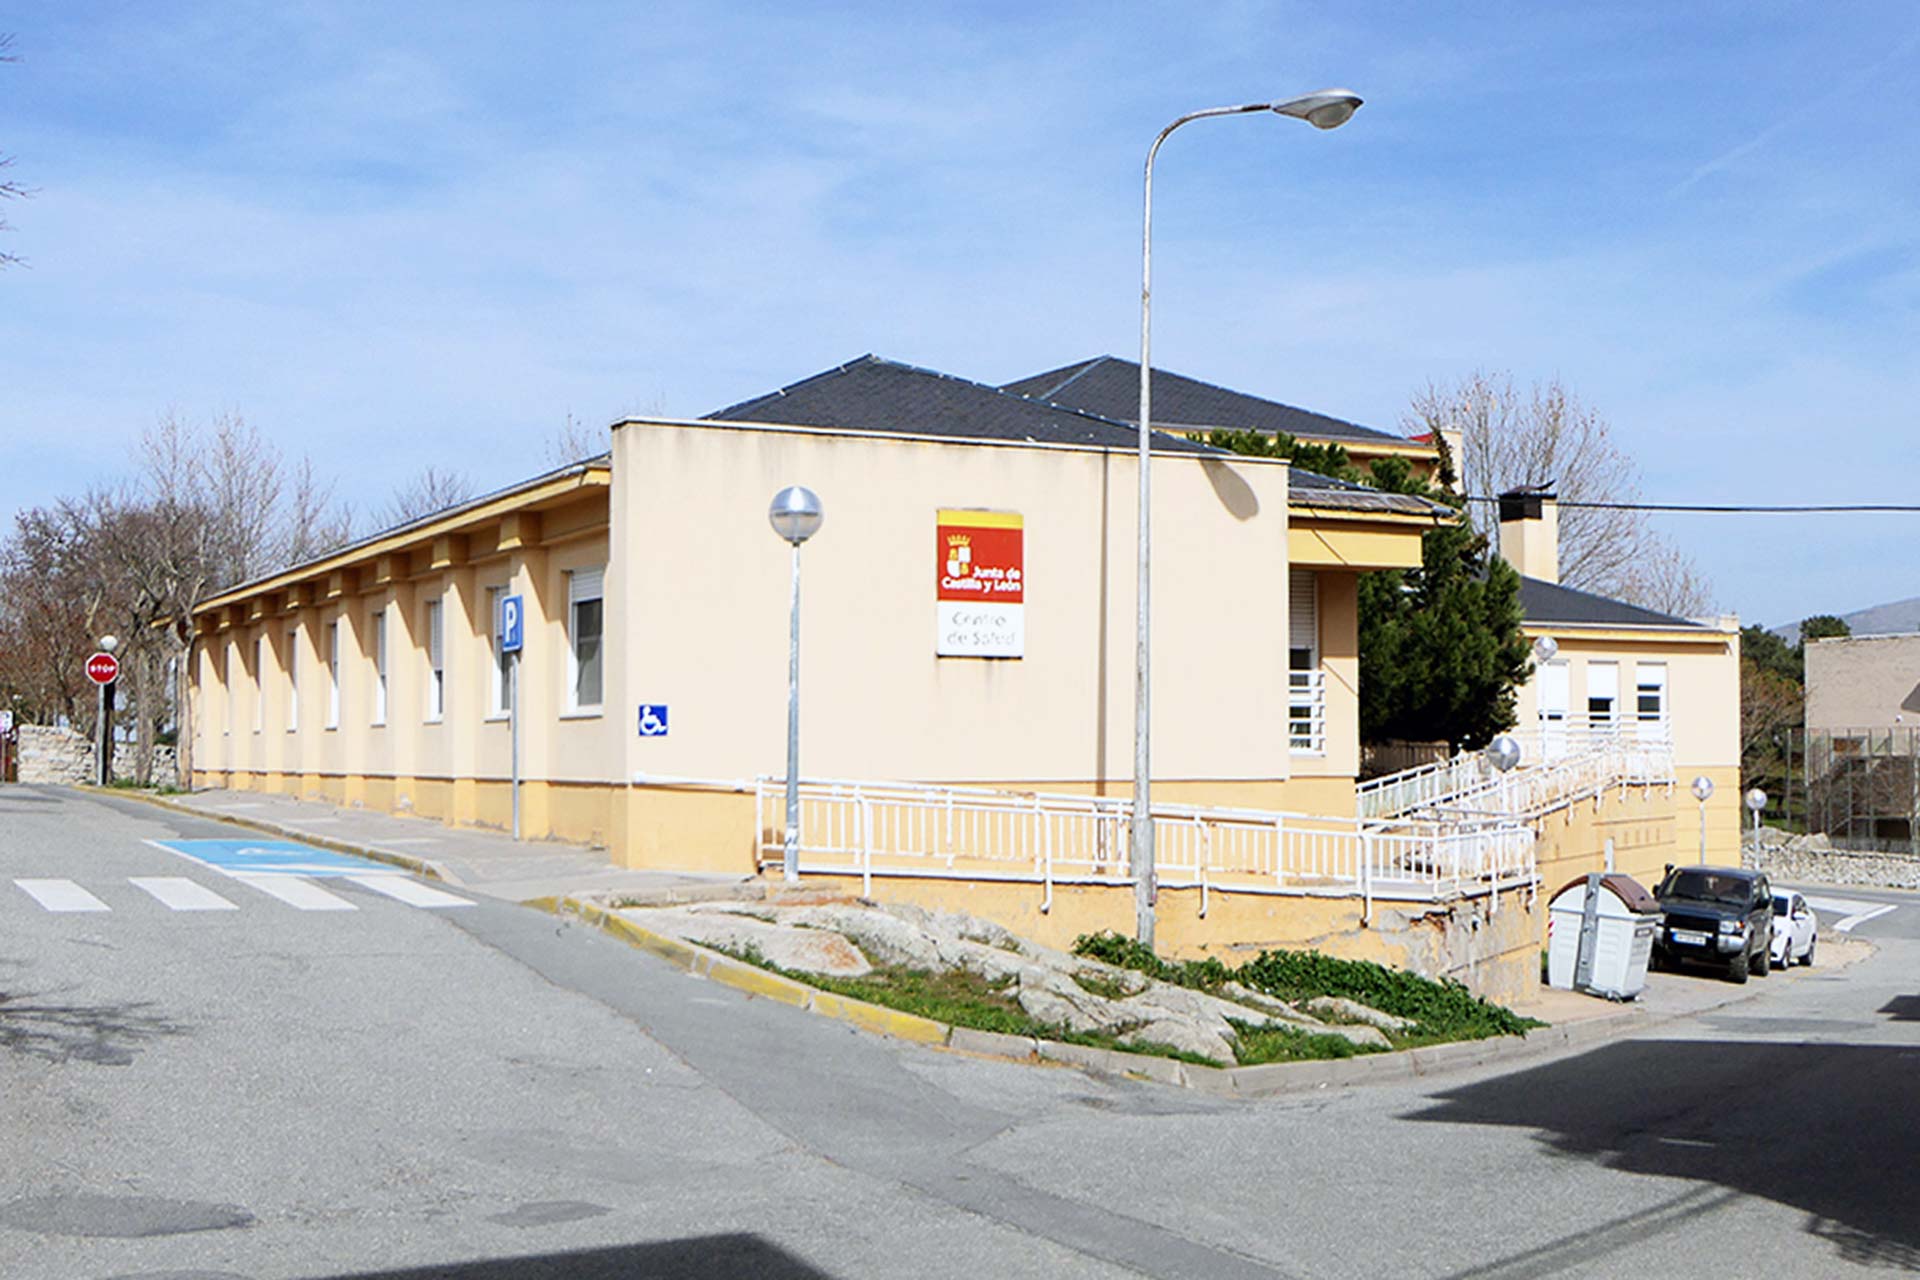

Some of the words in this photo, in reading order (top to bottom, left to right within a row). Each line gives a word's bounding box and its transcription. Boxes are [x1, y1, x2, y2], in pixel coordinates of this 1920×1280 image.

[973, 565, 1004, 579] Junta
[1006, 567, 1021, 580] de
[942, 576, 982, 590] Castilla
[983, 580, 993, 594] y
[994, 578, 1021, 591] León
[505, 601, 517, 642] P
[90, 663, 115, 673] STOP
